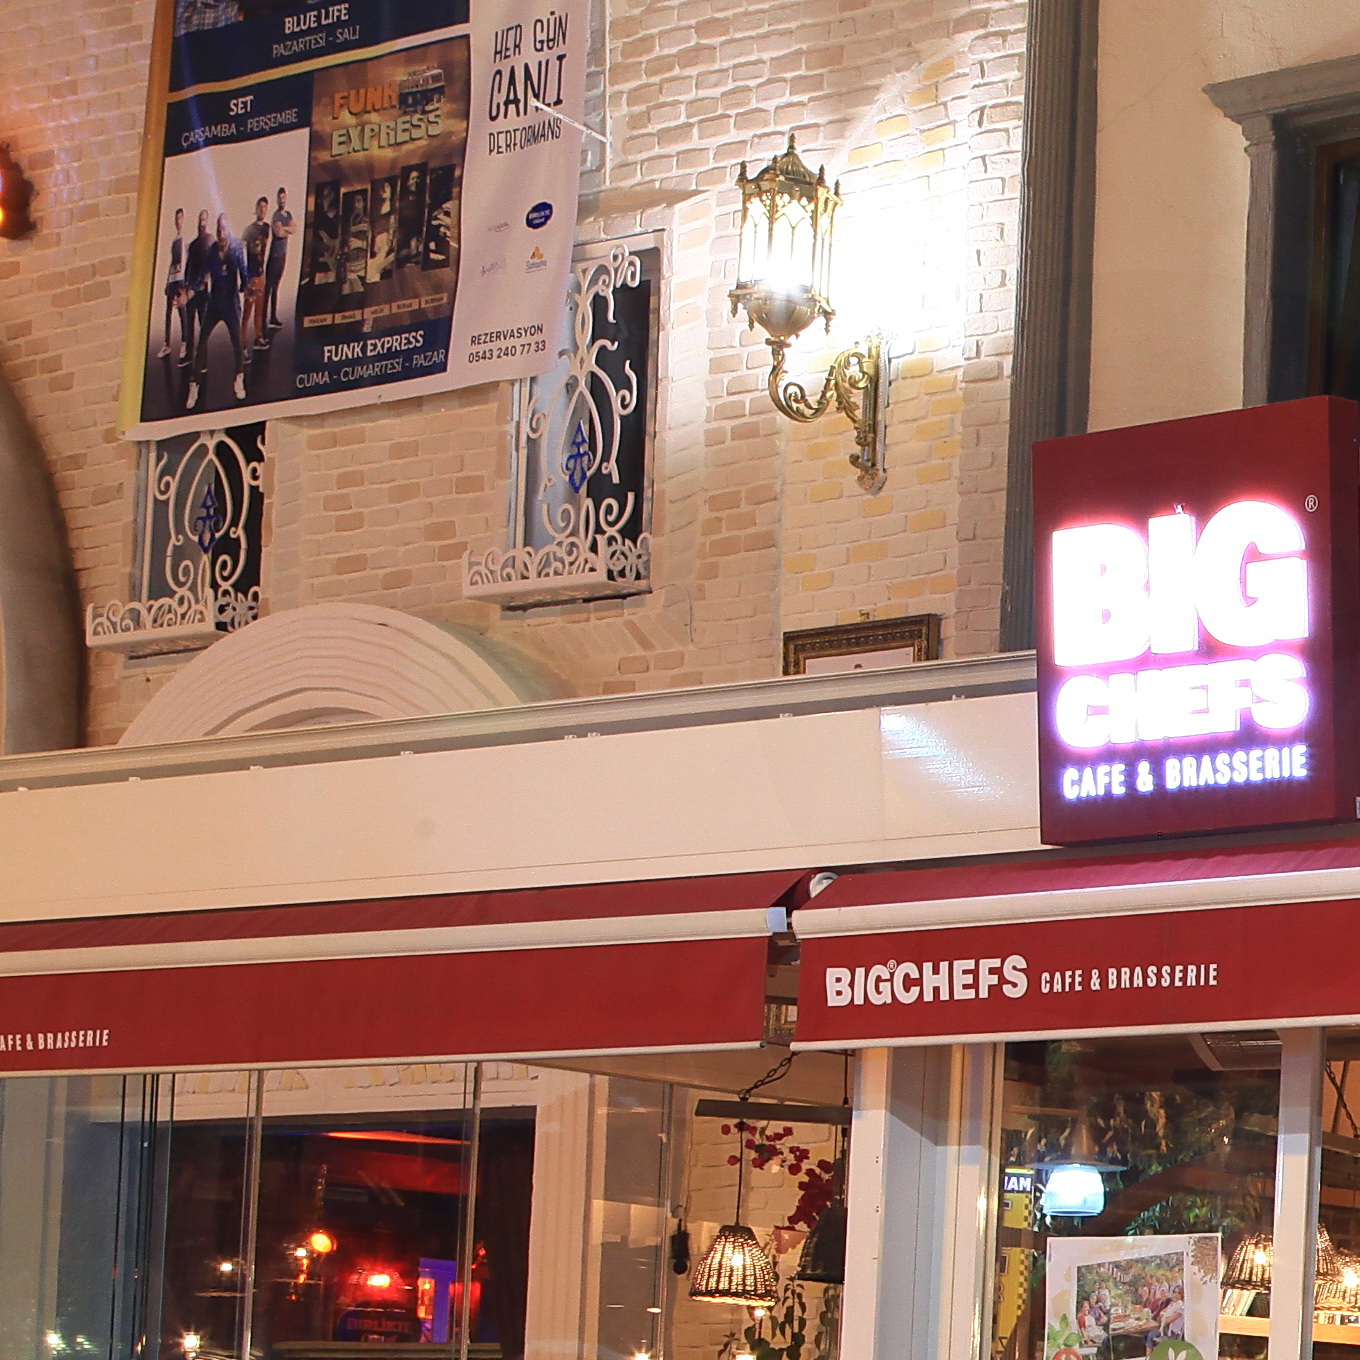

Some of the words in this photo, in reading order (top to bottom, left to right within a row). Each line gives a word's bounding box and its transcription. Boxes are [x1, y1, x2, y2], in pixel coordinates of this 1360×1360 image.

[284, 11, 318, 34] BLUE
[321, 3, 349, 25] LIFE
[272, 31, 327, 58] PAZARTESİ
[336, 25, 360, 43] SALI
[494, 23, 522, 64] HER
[332, 81, 399, 120] FUNK
[488, 53, 567, 122] CANLI
[228, 95, 255, 116] SET
[247, 108, 299, 132] PERŞEMBE
[330, 110, 442, 157] EXPRESS
[488, 117, 562, 155] PERFORMANS
[324, 341, 364, 363] FUNK
[367, 330, 424, 357] EXPRESS
[468, 348, 494, 364] 0543
[496, 345, 517, 359] 240
[520, 342, 532, 356] 77
[534, 339, 546, 353] 33
[470, 324, 543, 347] REZERVASYON
[296, 370, 330, 388] CUMA
[340, 356, 403, 382] CUMARTESİ
[412, 349, 446, 368] PAZAR
[1052, 500, 1309, 667] BIG
[1056, 653, 1310, 748] CHEFS
[1063, 763, 1126, 800] CAFE
[1136, 759, 1154, 792] &
[1165, 744, 1309, 790] BRASSERIE
[1041, 969, 1083, 993] CAFE
[1090, 968, 1101, 990] &
[1108, 963, 1219, 989] BRASSERIE
[26, 1033, 34, 1051] &
[38, 1029, 110, 1050] BRASSERIE
